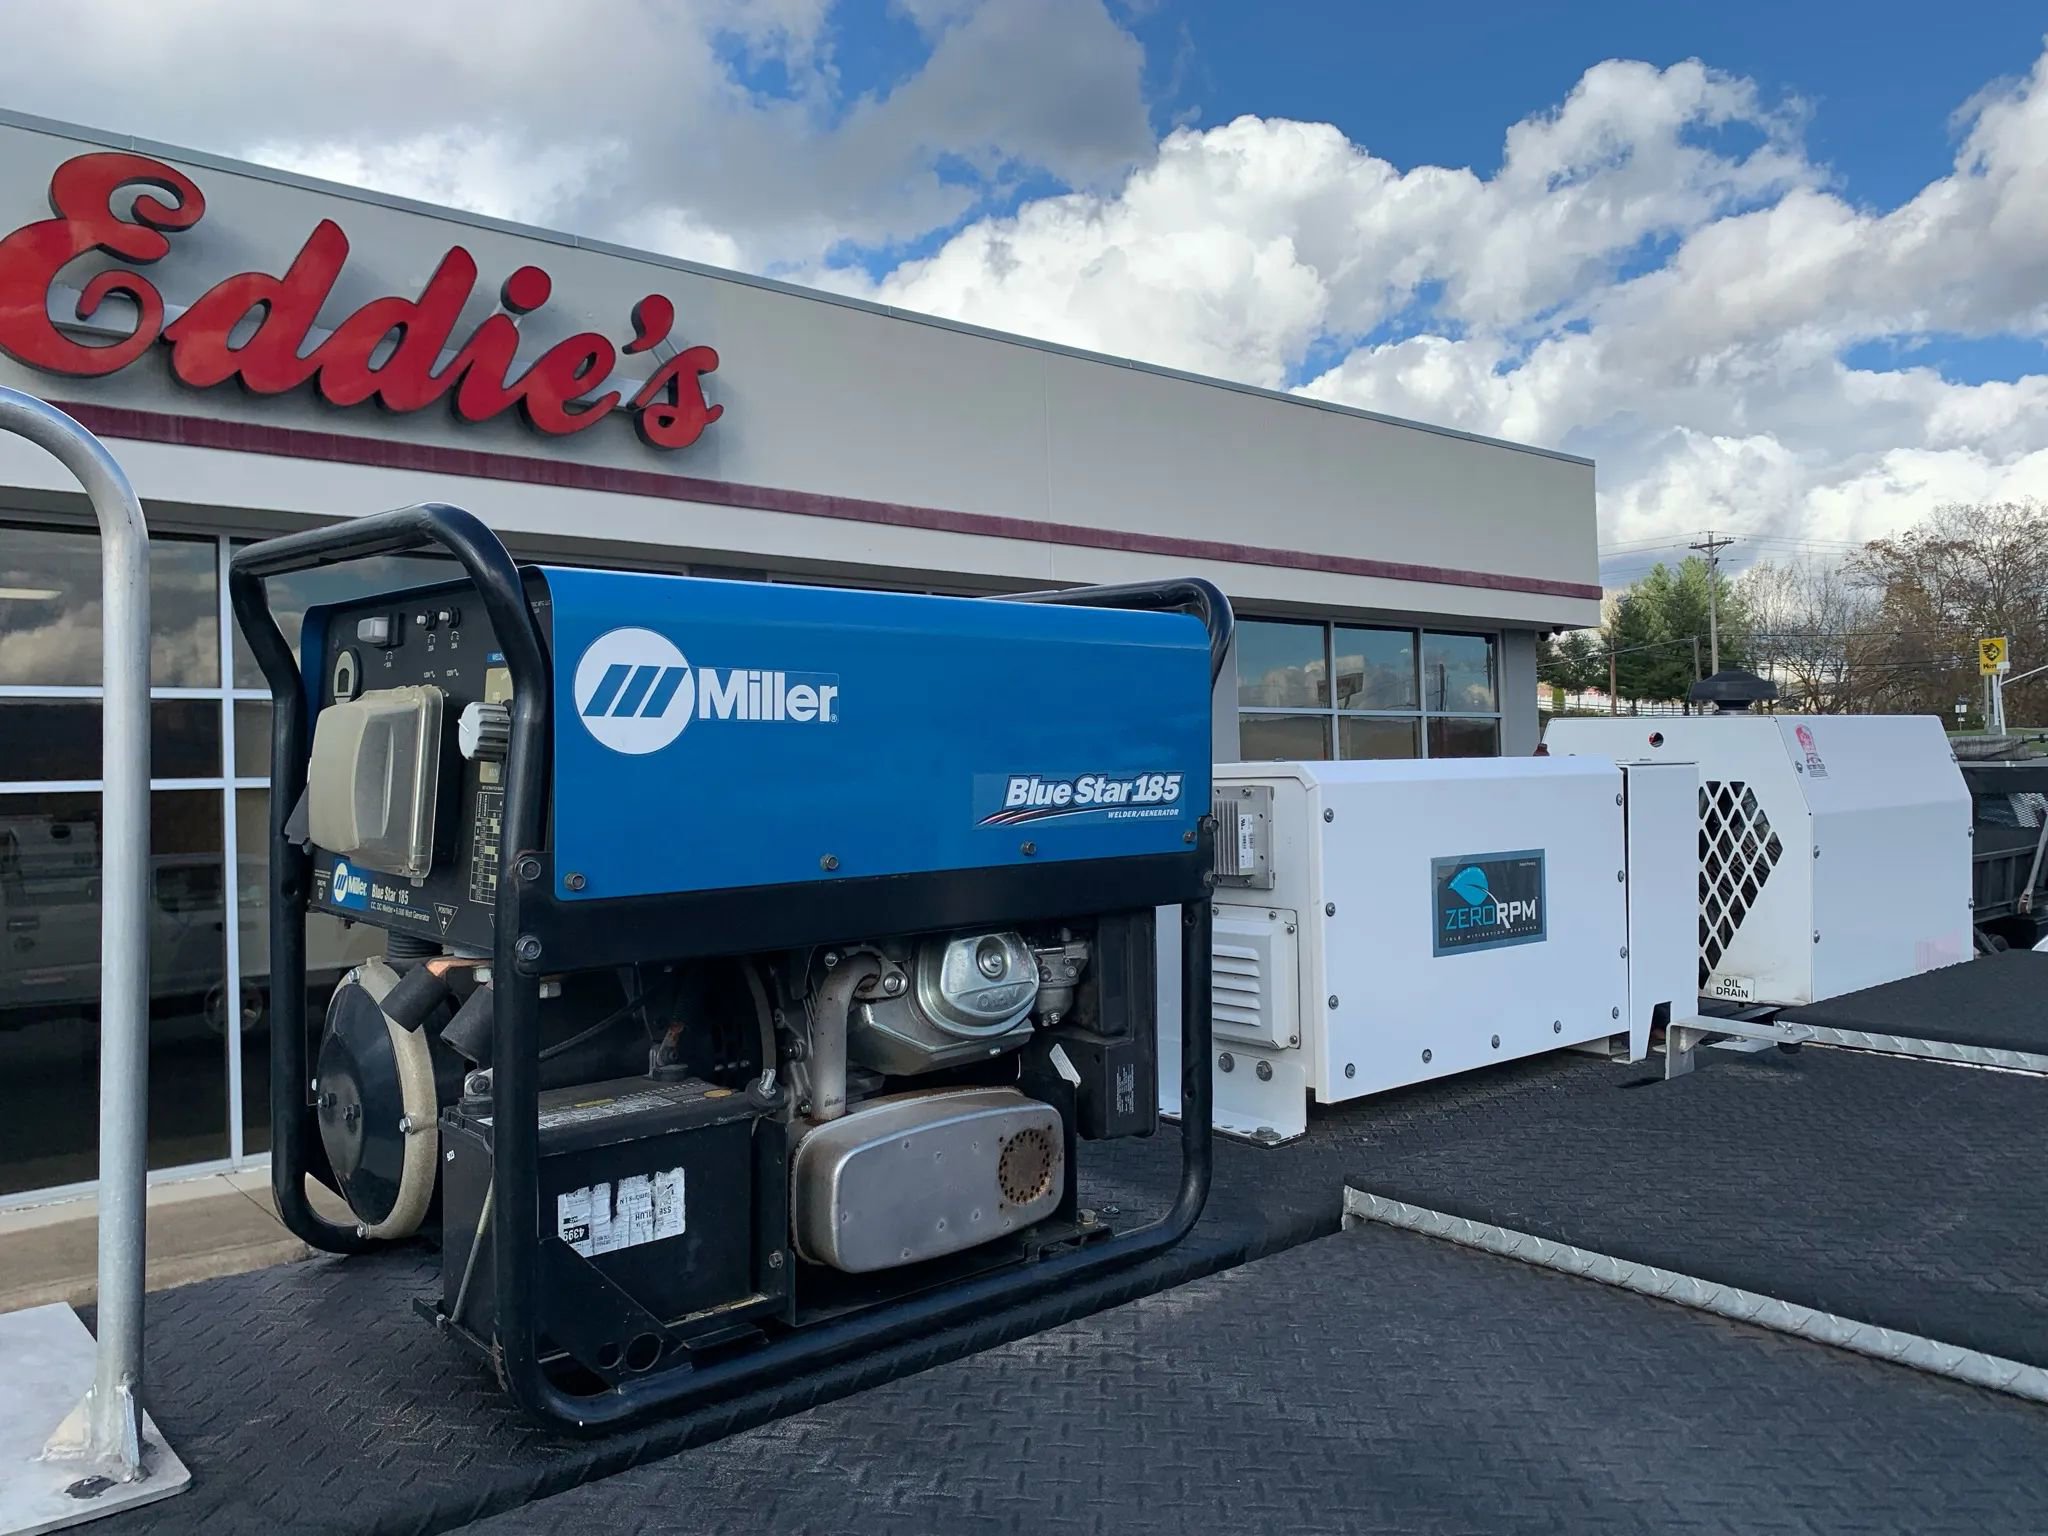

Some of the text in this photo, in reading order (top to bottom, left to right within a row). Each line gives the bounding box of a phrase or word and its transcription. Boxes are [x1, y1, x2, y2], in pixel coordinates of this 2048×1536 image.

[0, 152, 723, 450] Eddie's
[699, 668, 837, 722] Miller
[1005, 774, 1181, 807] Blue Star 185
[1108, 808, 1180, 819] WELDER/GENERATOR
[347, 876, 367, 896] Miller
[371, 883, 409, 905] Blue Star 185
[1715, 986, 1749, 999] DRAIN
[1723, 978, 1741, 988] OIL
